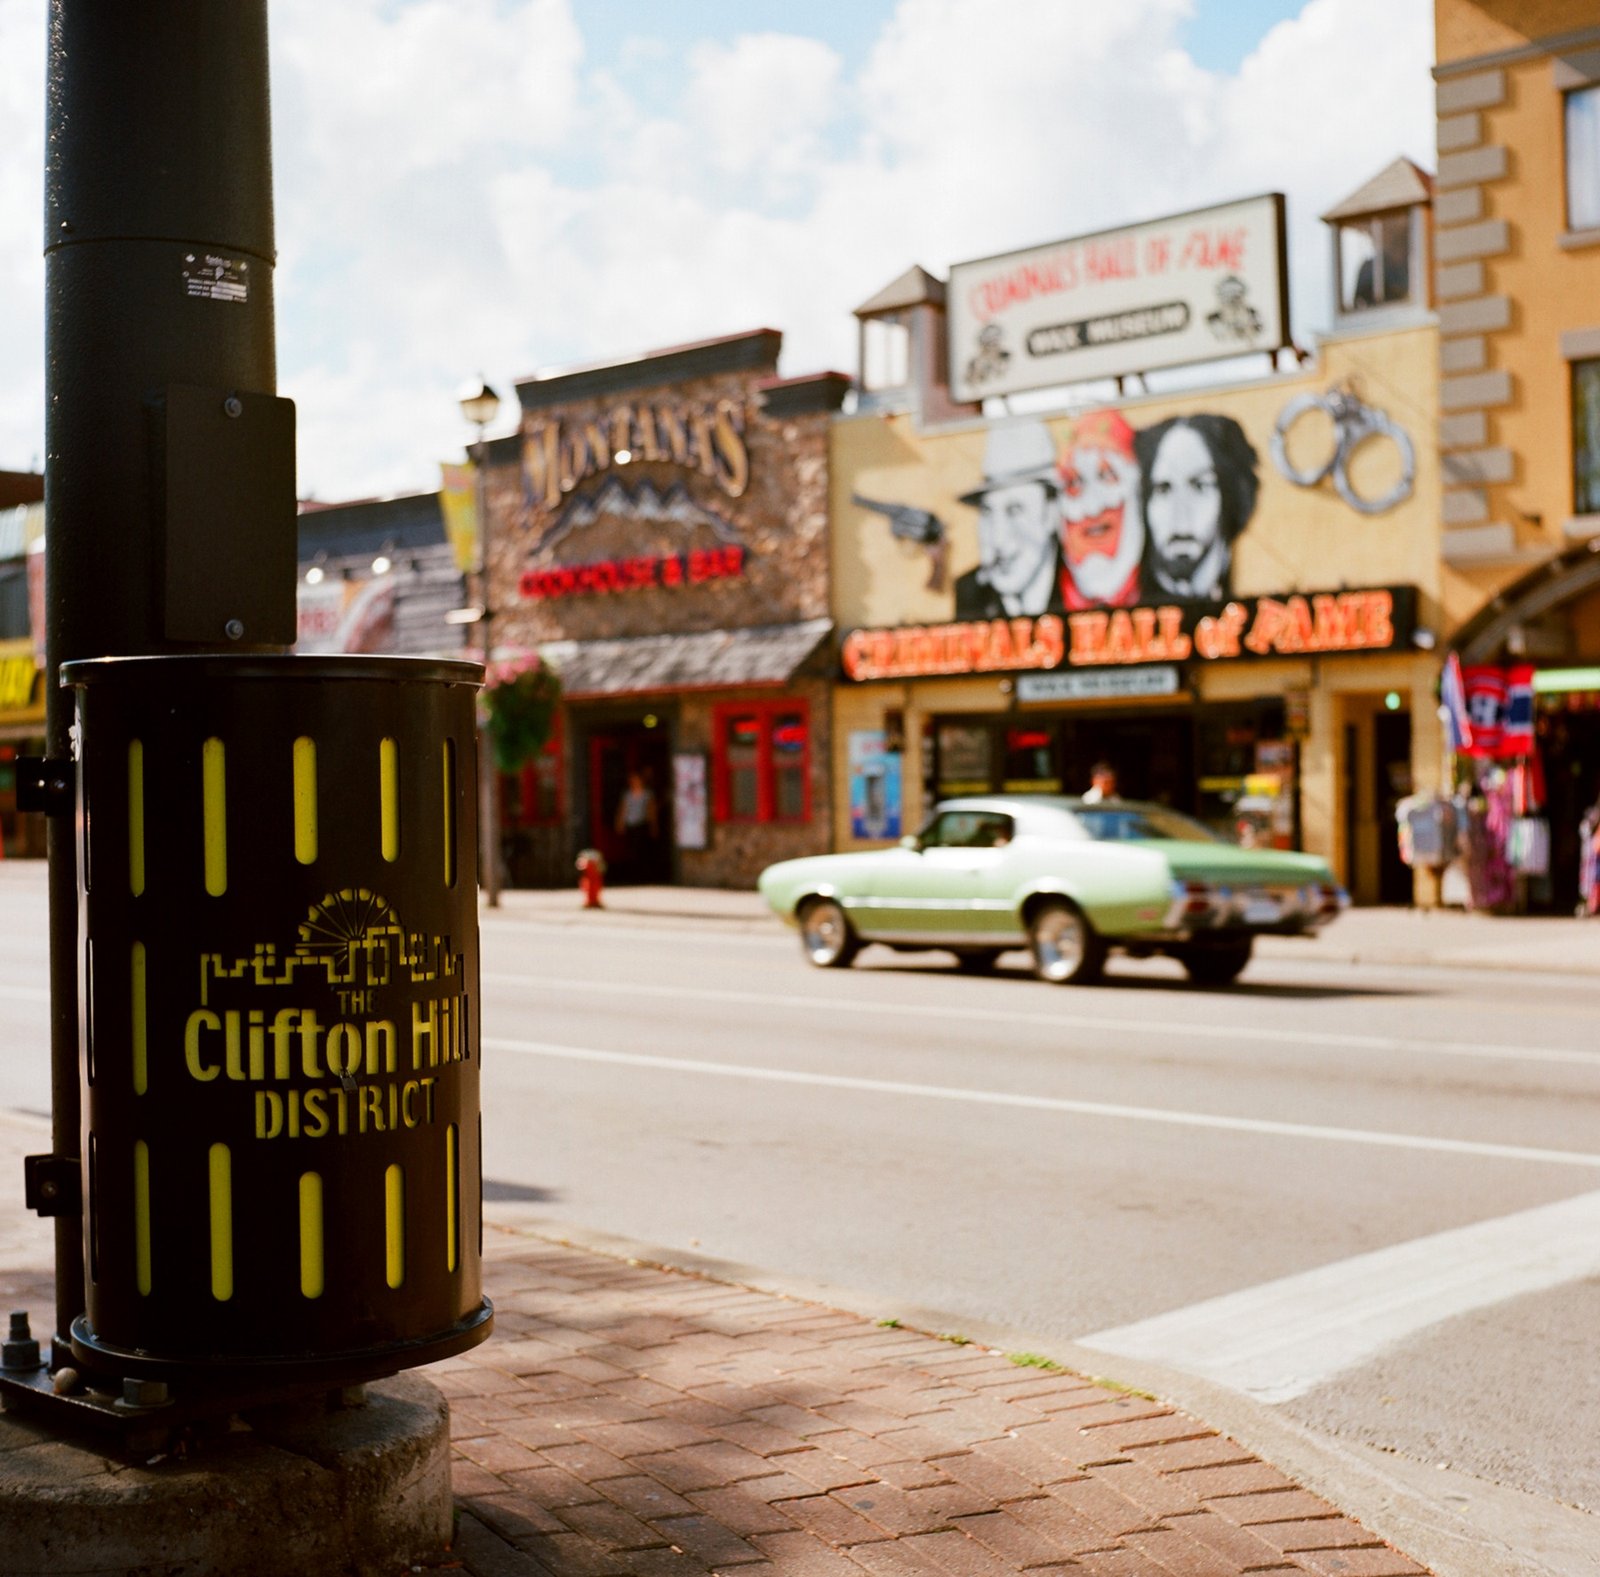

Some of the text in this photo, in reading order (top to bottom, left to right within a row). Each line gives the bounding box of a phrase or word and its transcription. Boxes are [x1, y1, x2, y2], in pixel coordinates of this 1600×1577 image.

[1068, 606, 1192, 666] HALL
[1245, 589, 1394, 655] FAME
[337, 990, 378, 1015] THE
[184, 994, 470, 1081] Clifton Hill
[255, 1077, 439, 1139] DISTRICT
